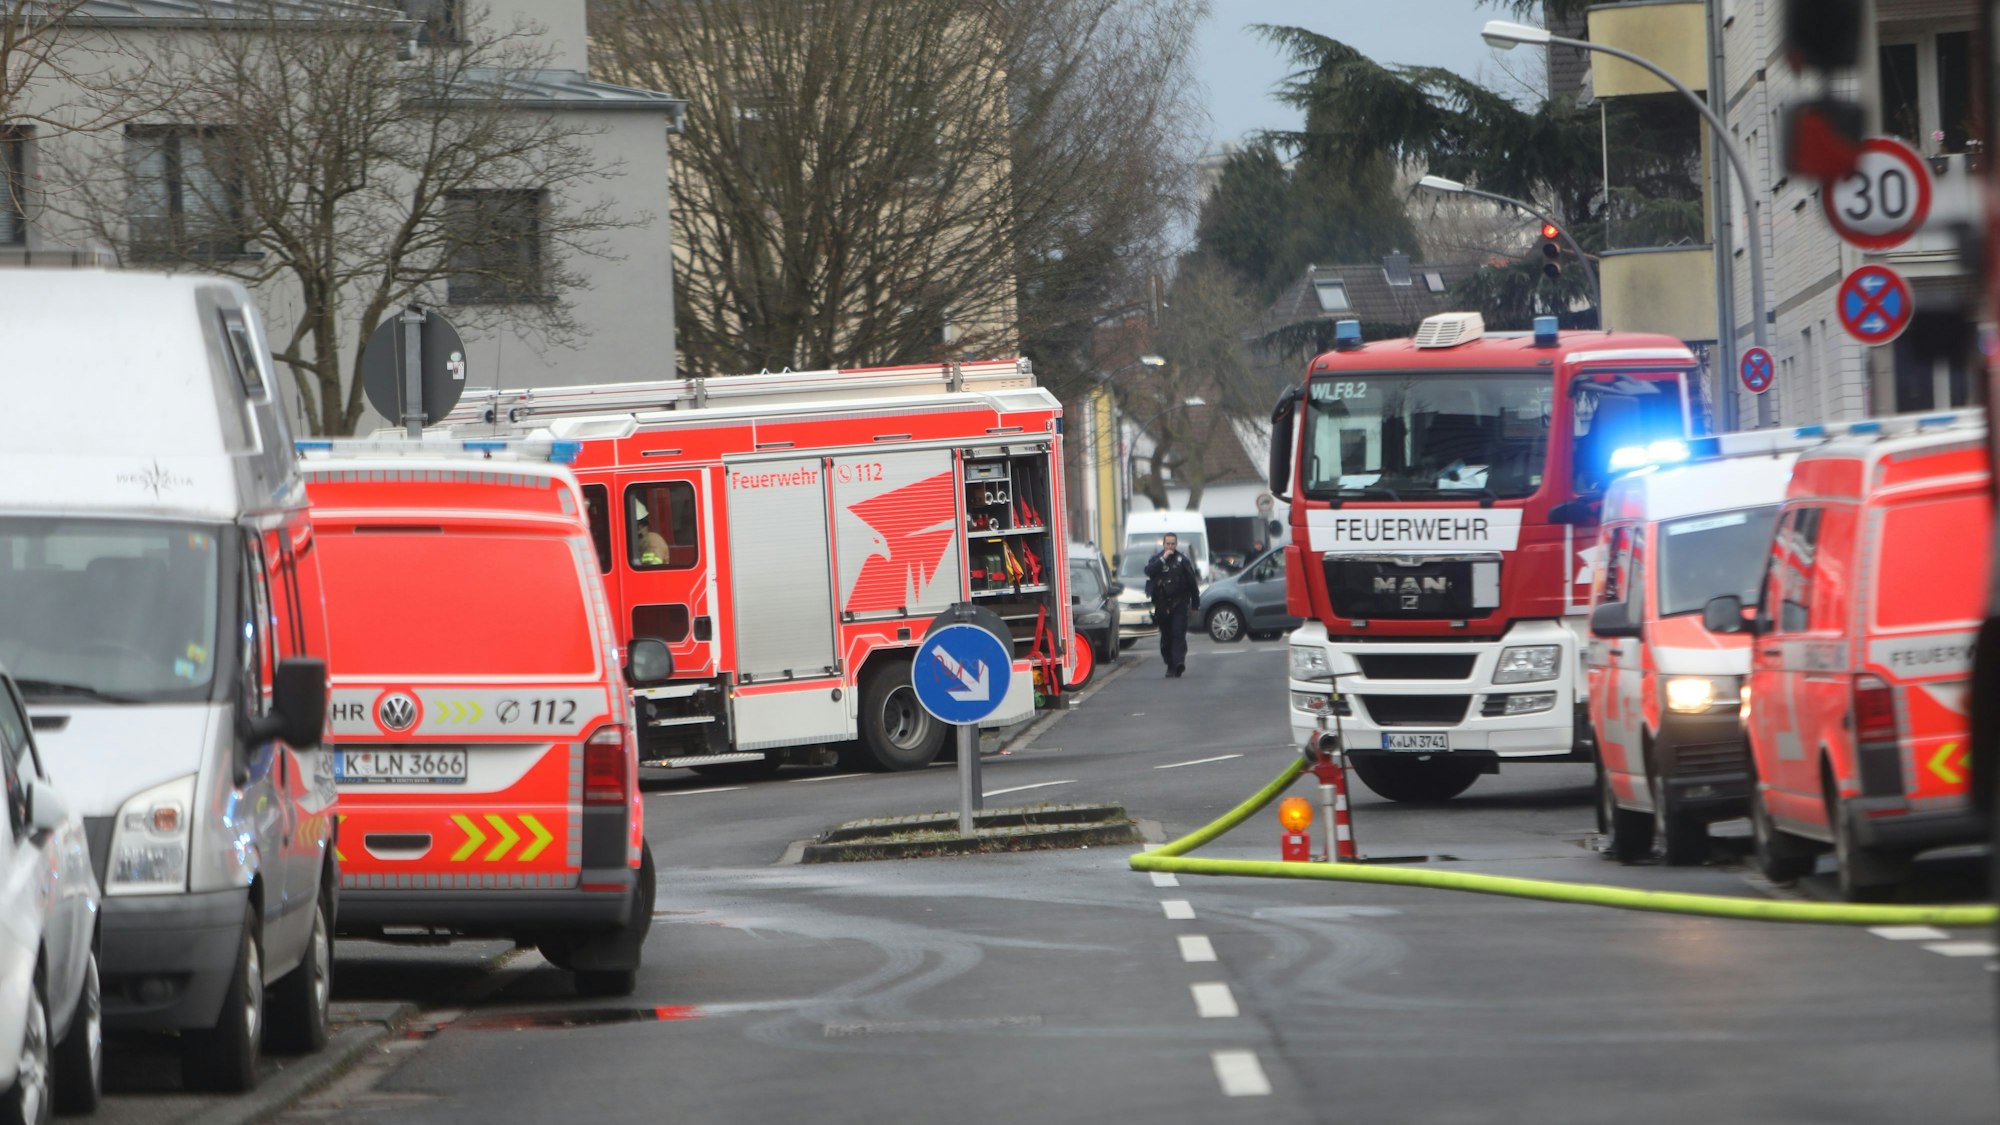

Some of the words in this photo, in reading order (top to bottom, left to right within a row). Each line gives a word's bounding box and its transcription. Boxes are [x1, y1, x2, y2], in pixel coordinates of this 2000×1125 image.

[1844, 169, 1907, 221] 30
[115, 472, 195, 488] WESALIA
[732, 466, 818, 490] Feuerwehr
[855, 463, 883, 482] 112
[1335, 518, 1489, 542] FEUERWEHR
[1374, 577, 1447, 594] MAN
[332, 703, 365, 722] HR
[530, 699, 577, 725] 112
[1389, 735, 1396, 748] K
[1402, 735, 1417, 748] LN
[1419, 735, 1446, 748] 3741
[345, 755, 360, 776] K
[375, 754, 404, 775] LN
[409, 754, 464, 775] 3666
